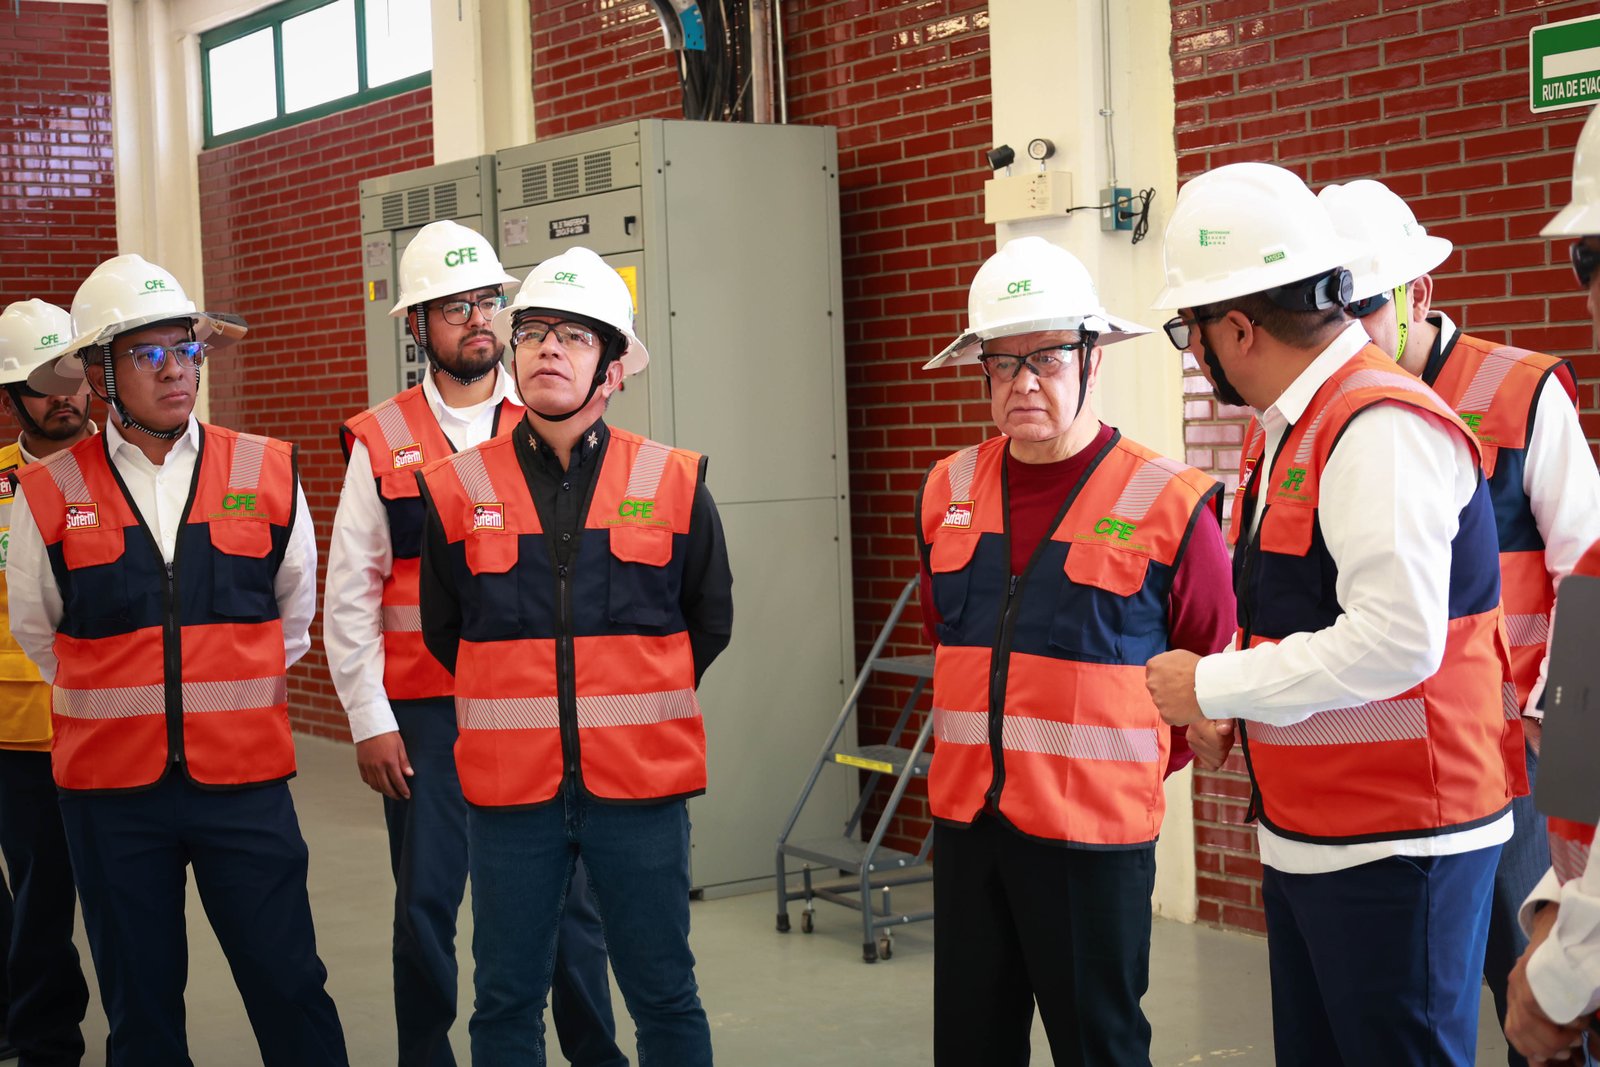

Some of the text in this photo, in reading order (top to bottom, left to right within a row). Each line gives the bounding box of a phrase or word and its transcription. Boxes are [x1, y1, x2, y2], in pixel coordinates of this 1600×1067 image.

[1543, 82, 1565, 101] RUTA
[1566, 79, 1578, 97] DE
[444, 247, 478, 267] CFE
[145, 279, 166, 290] CFE
[554, 271, 578, 282] CFE
[1007, 279, 1032, 294] CFE
[41, 334, 59, 346] CFE
[223, 493, 257, 510] CFE
[619, 499, 655, 518] CFE
[66, 512, 96, 529] Suterm
[1093, 517, 1137, 541] CFE
